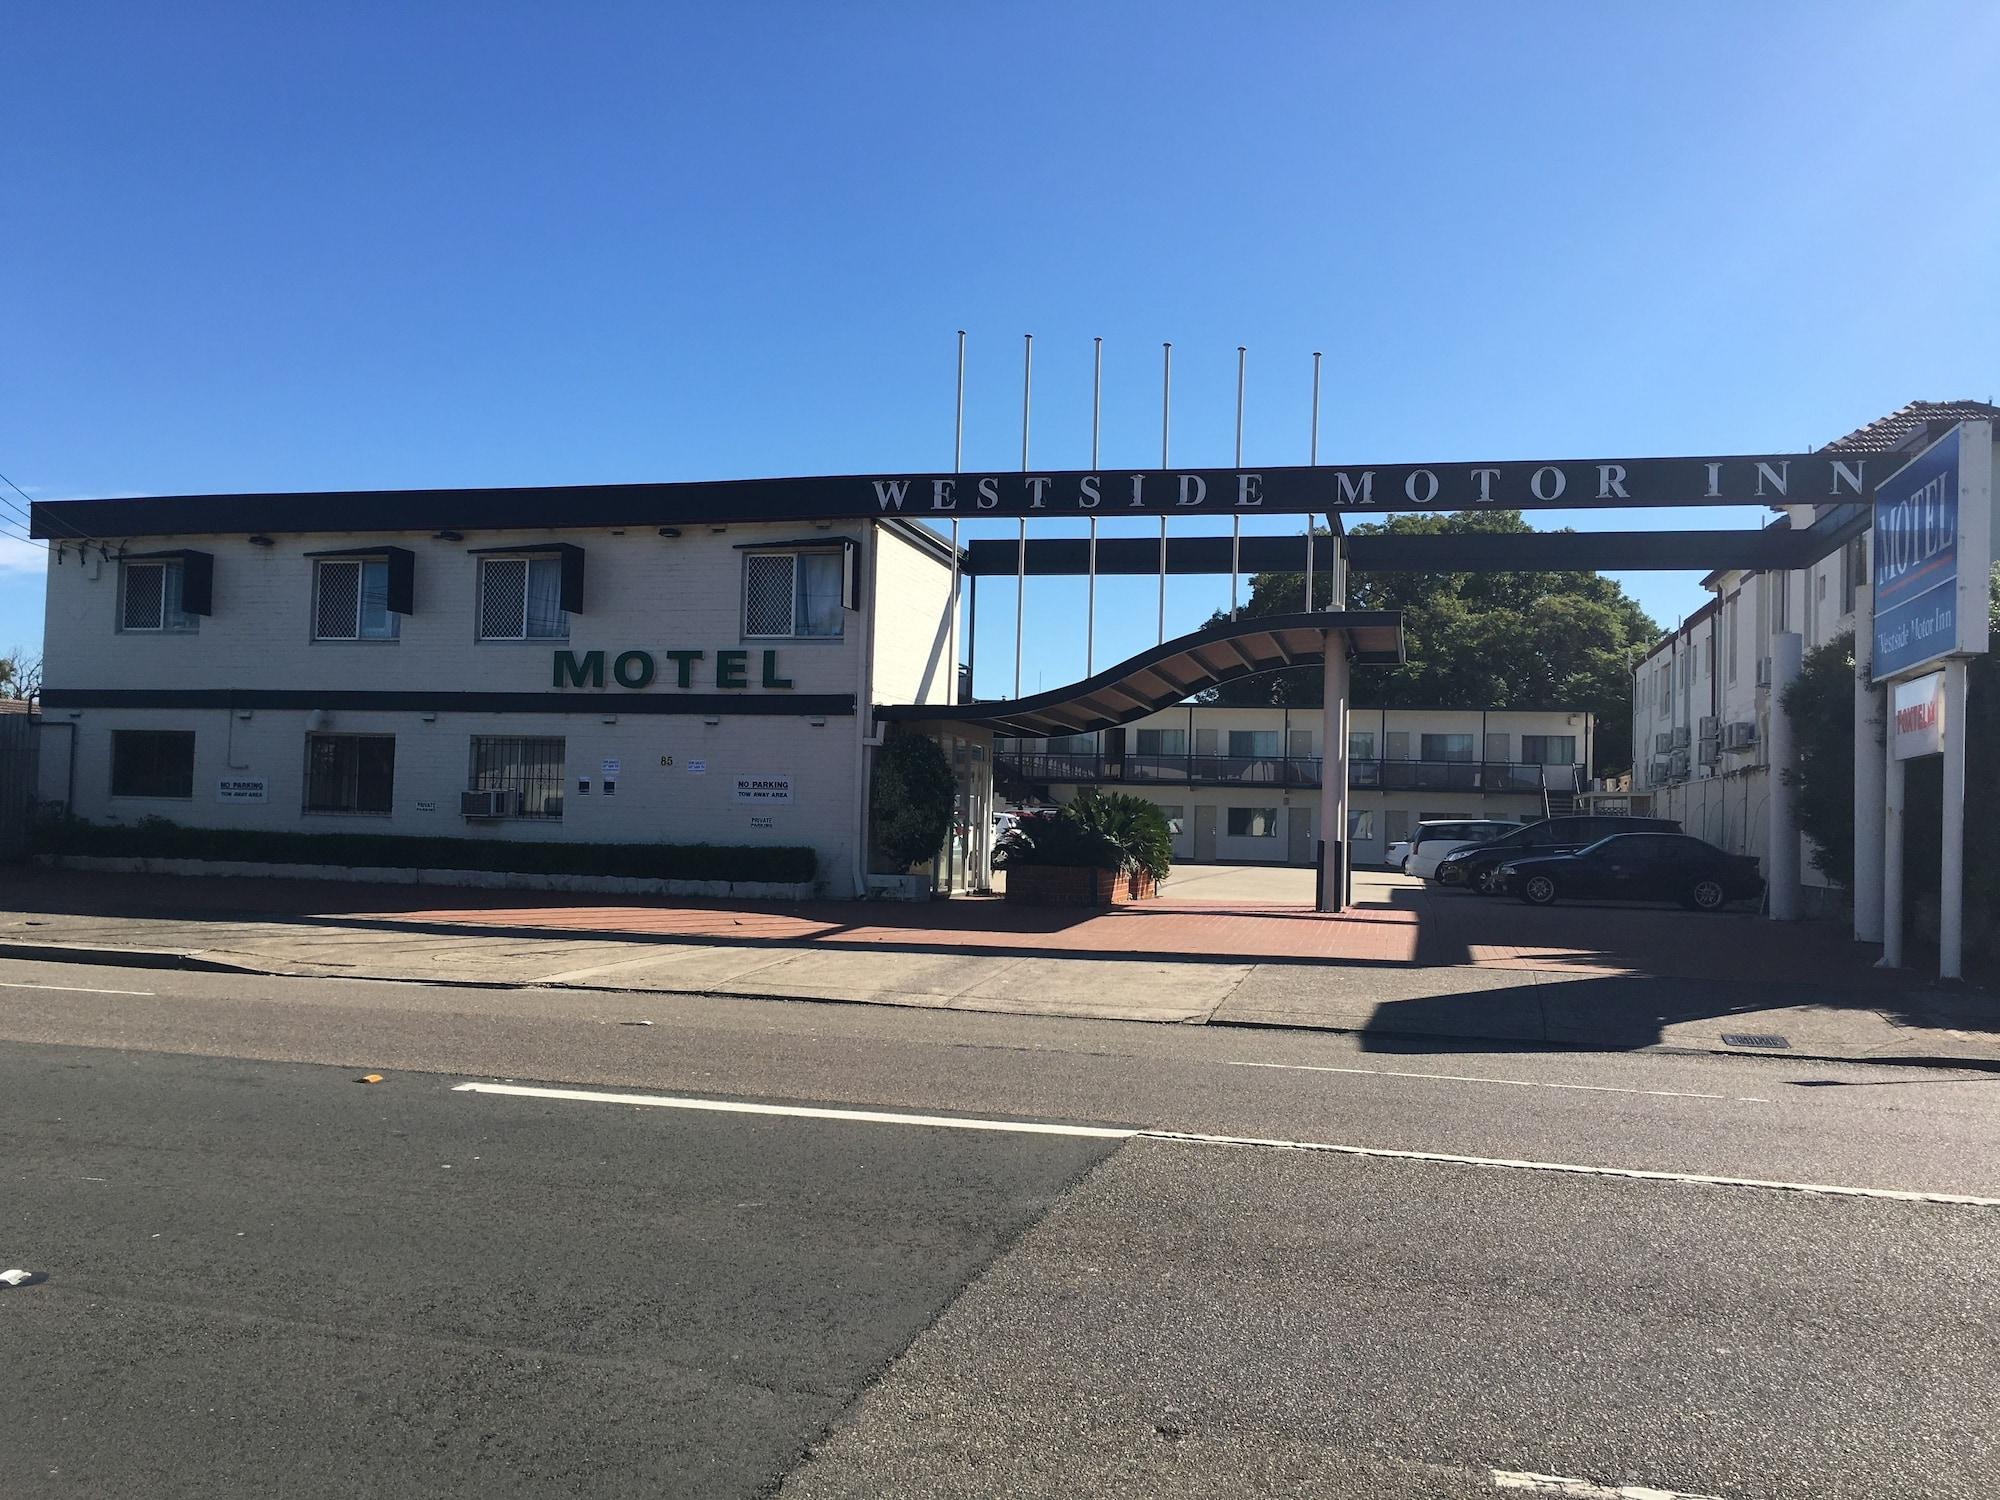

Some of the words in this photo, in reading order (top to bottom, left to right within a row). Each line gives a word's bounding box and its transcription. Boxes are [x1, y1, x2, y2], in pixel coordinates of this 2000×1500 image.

[872, 473, 1264, 511] WESTSIDE
[1334, 463, 1632, 505] MOTOR
[1703, 459, 1866, 496] INN
[1879, 471, 1953, 585] MOTEL
[1935, 607, 1952, 632] Inn
[552, 650, 794, 689] MOTEL
[661, 756, 673, 767] 85
[233, 782, 263, 790] PARKING
[752, 781, 788, 789] PARKING
